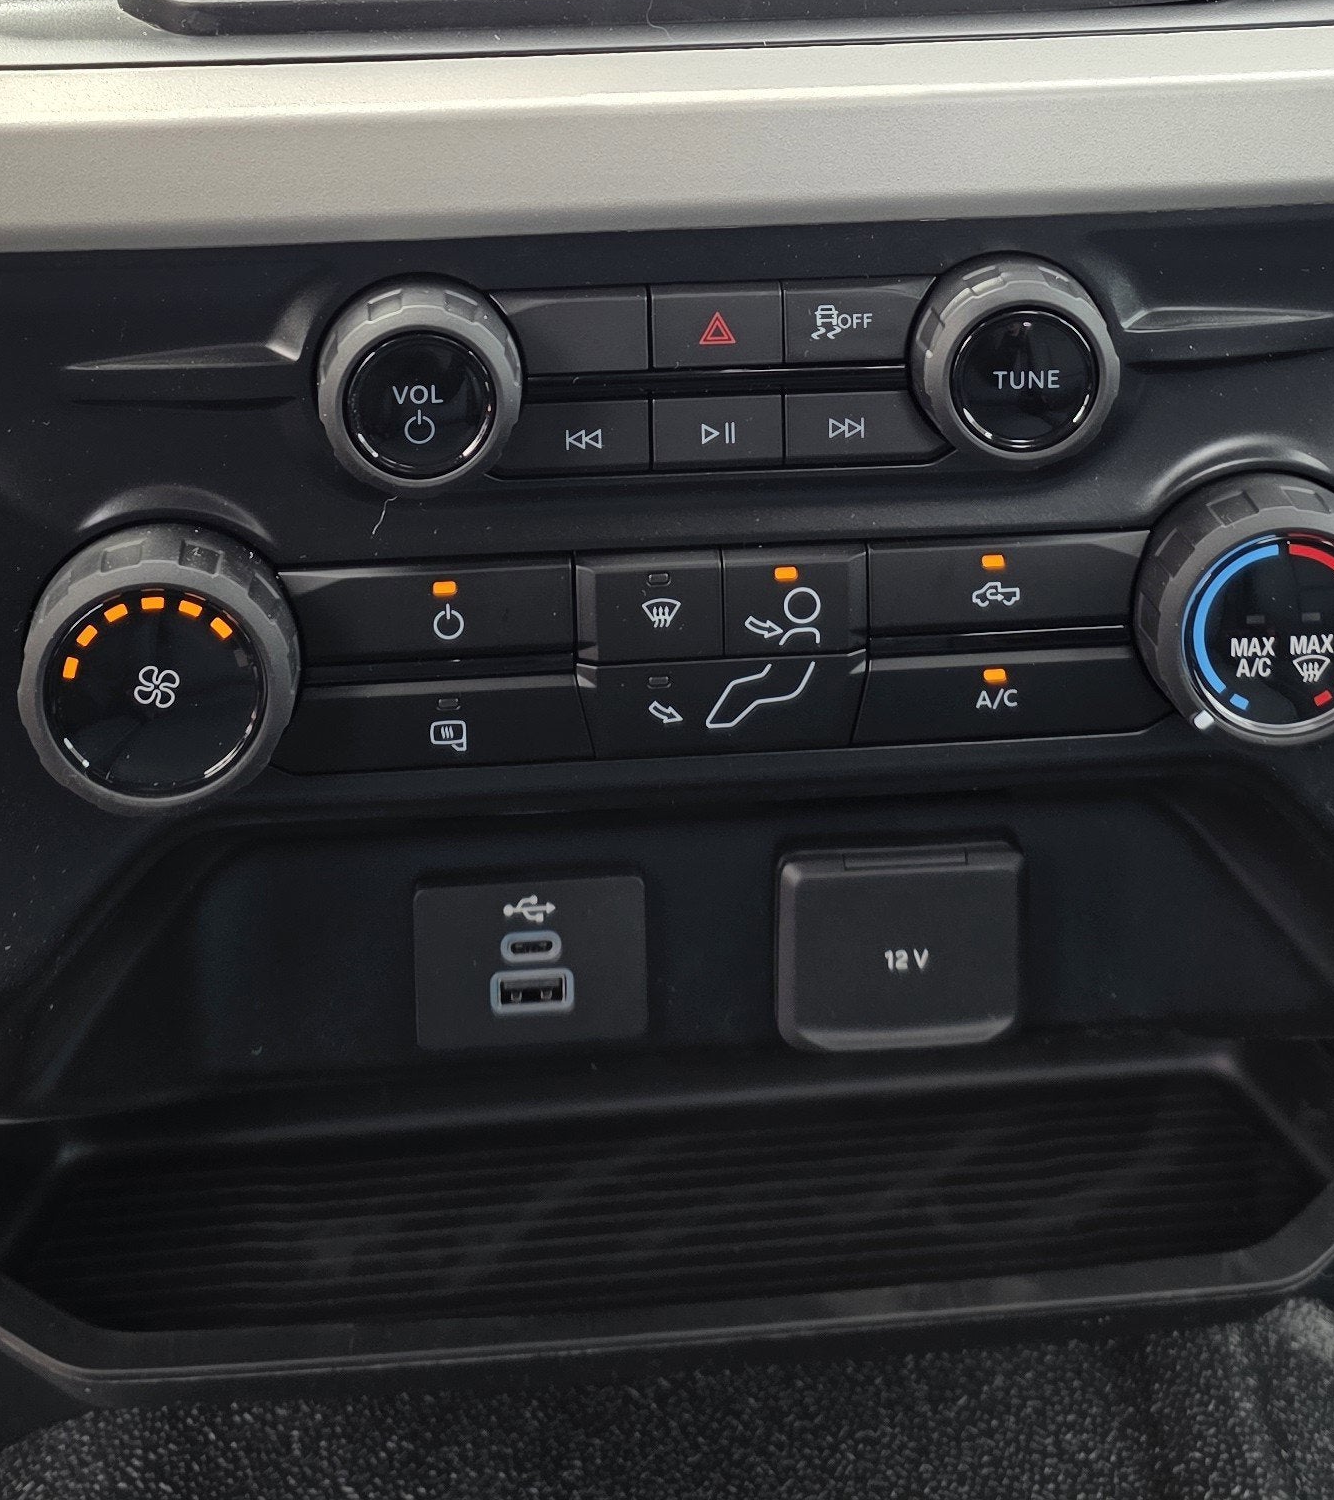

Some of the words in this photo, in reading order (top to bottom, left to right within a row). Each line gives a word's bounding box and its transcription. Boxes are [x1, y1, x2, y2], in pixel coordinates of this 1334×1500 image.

[838, 313, 873, 329] OFF
[993, 369, 1060, 390] TUNE
[392, 384, 444, 404] VOL
[1230, 636, 1276, 657] MAX
[1289, 633, 1334, 655] MAX
[1235, 657, 1272, 678] A/C
[975, 688, 1018, 710] A/C
[884, 949, 909, 970] 12
[913, 948, 929, 969] V
